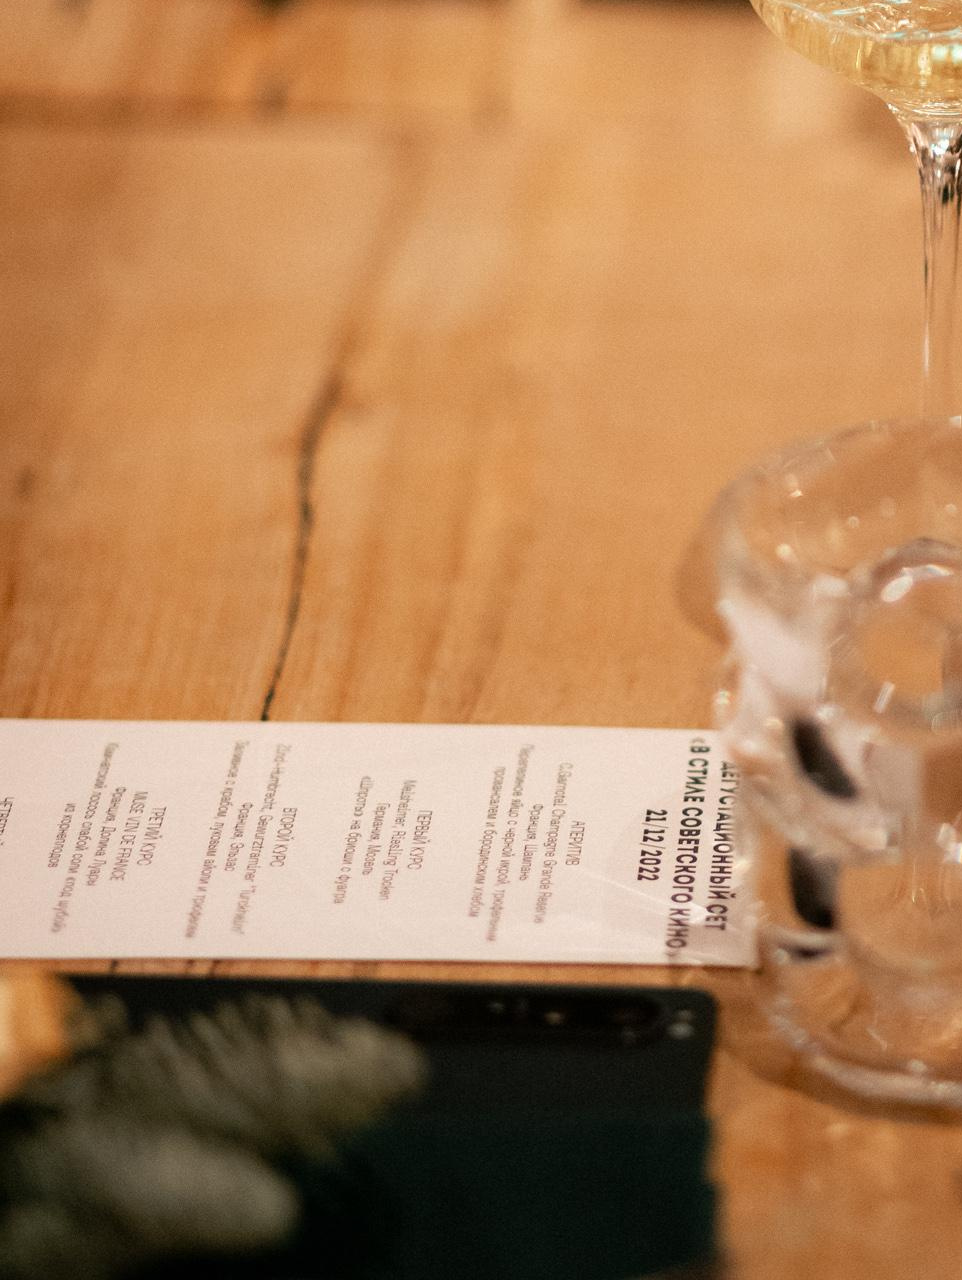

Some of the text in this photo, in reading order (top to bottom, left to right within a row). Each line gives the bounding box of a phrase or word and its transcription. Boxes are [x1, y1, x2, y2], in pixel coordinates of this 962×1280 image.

[486, 766, 505, 819] провансалем
[683, 758, 708, 802] СТИЛЕ
[83, 791, 101, 818] лосось
[128, 791, 148, 813] MUSE
[507, 799, 523, 817] яйцо
[74, 821, 92, 851] слабой
[85, 786, 126, 886] Франция, Долина Луары
[123, 816, 140, 831] VIN
[136, 806, 166, 865] ТРЕТИЙ КУРС
[205, 821, 224, 856] луковым
[223, 802, 253, 871] Франция, Эльзас
[269, 807, 297, 866] ВТОРОЙ КУРС
[361, 802, 390, 875] Германия, Мозель
[407, 810, 433, 869] ПЕРВЫЙ КУРС
[543, 809, 565, 856] Champagne
[47, 815, 72, 867] корнеплодов
[342, 832, 362, 864] бриоши
[383, 831, 406, 865] Riesling
[474, 829, 497, 884] бородинским
[501, 828, 515, 857] черной
[518, 803, 543, 880] Франция, Шампань
[565, 820, 585, 865] АПЕРИТИВ
[637, 809, 667, 880] 21/12/2022
[671, 807, 702, 903] СОВЕТСКОГО
[705, 761, 737, 930] ДЕГУСТАЦИОННЫЙ СЕТ
[67, 853, 83, 873] соли
[110, 847, 132, 880] FRANCE
[198, 858, 216, 884] айоли
[495, 860, 510, 886] икрой,
[539, 860, 557, 889] Grande
[332, 874, 350, 903] фуагра
[379, 869, 398, 900] Trocken
[467, 887, 484, 917] хлебом
[533, 892, 551, 923] Reserve
